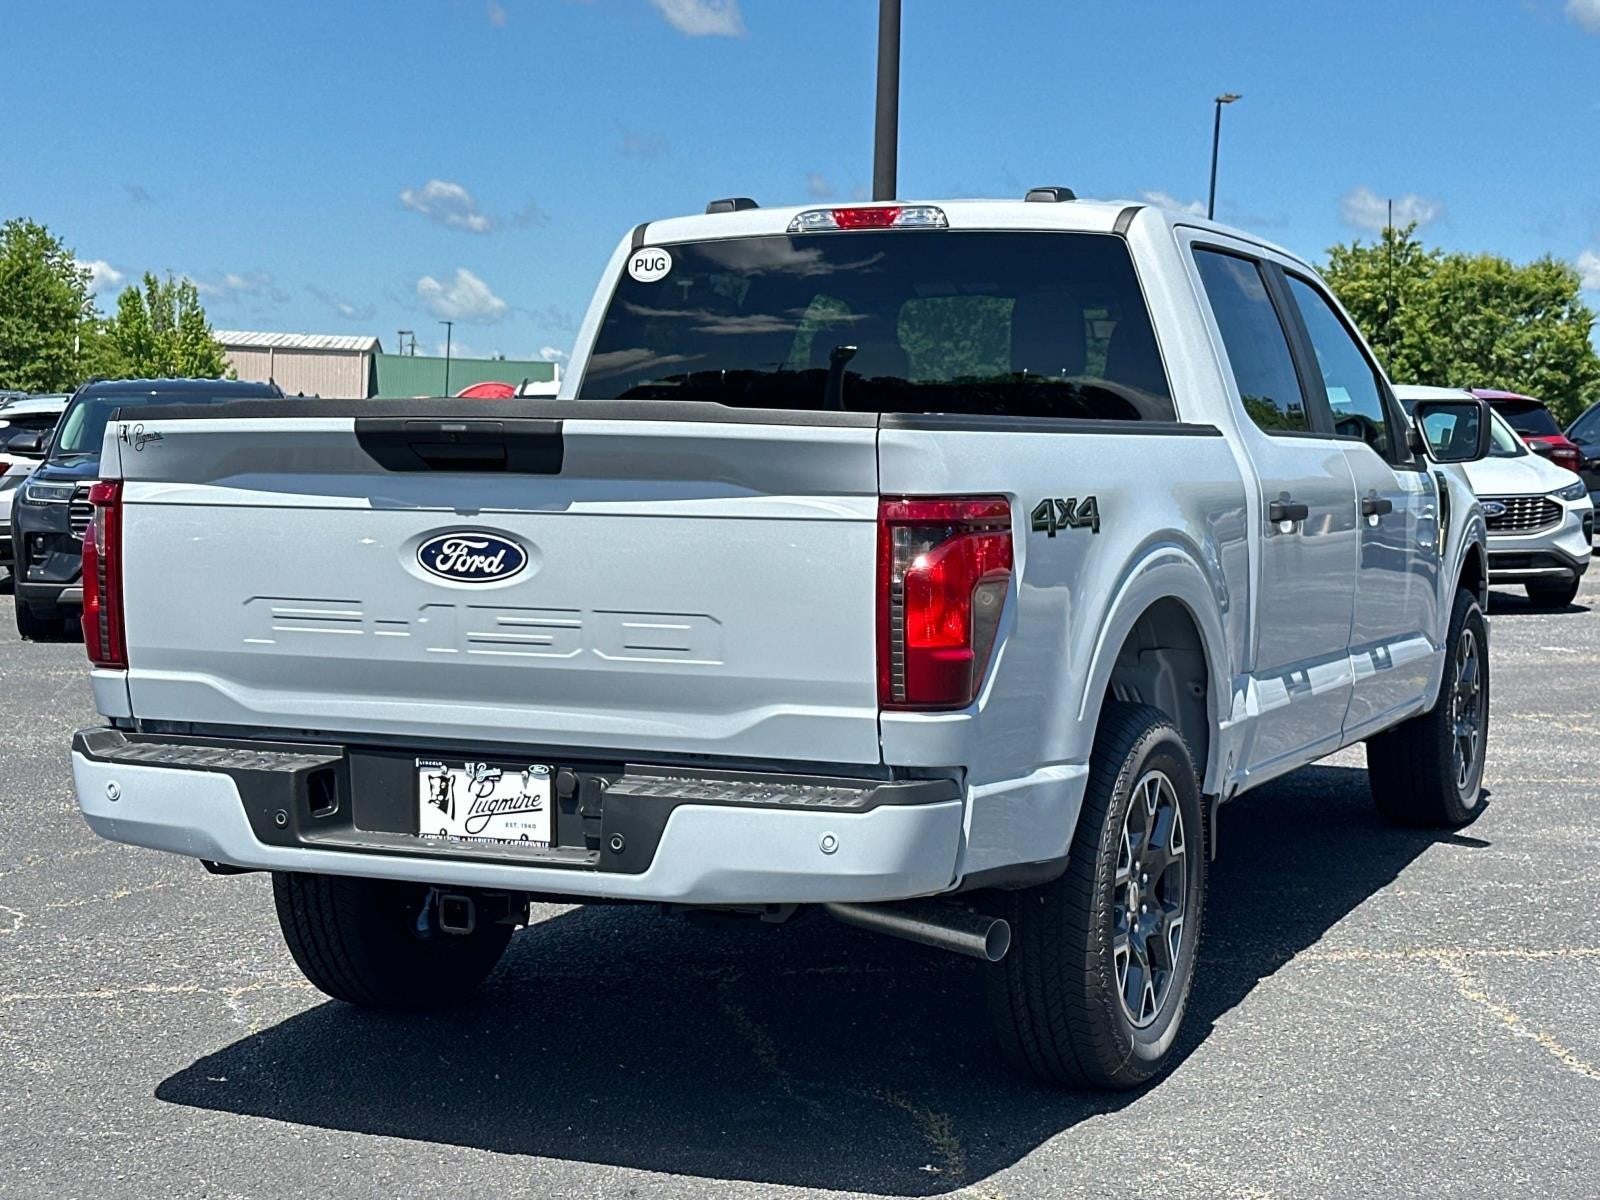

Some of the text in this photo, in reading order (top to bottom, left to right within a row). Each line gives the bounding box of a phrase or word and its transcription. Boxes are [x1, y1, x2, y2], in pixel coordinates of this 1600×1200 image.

[635, 257, 666, 273] PUG
[435, 539, 506, 574] Ford
[465, 777, 543, 834] Pugmire
